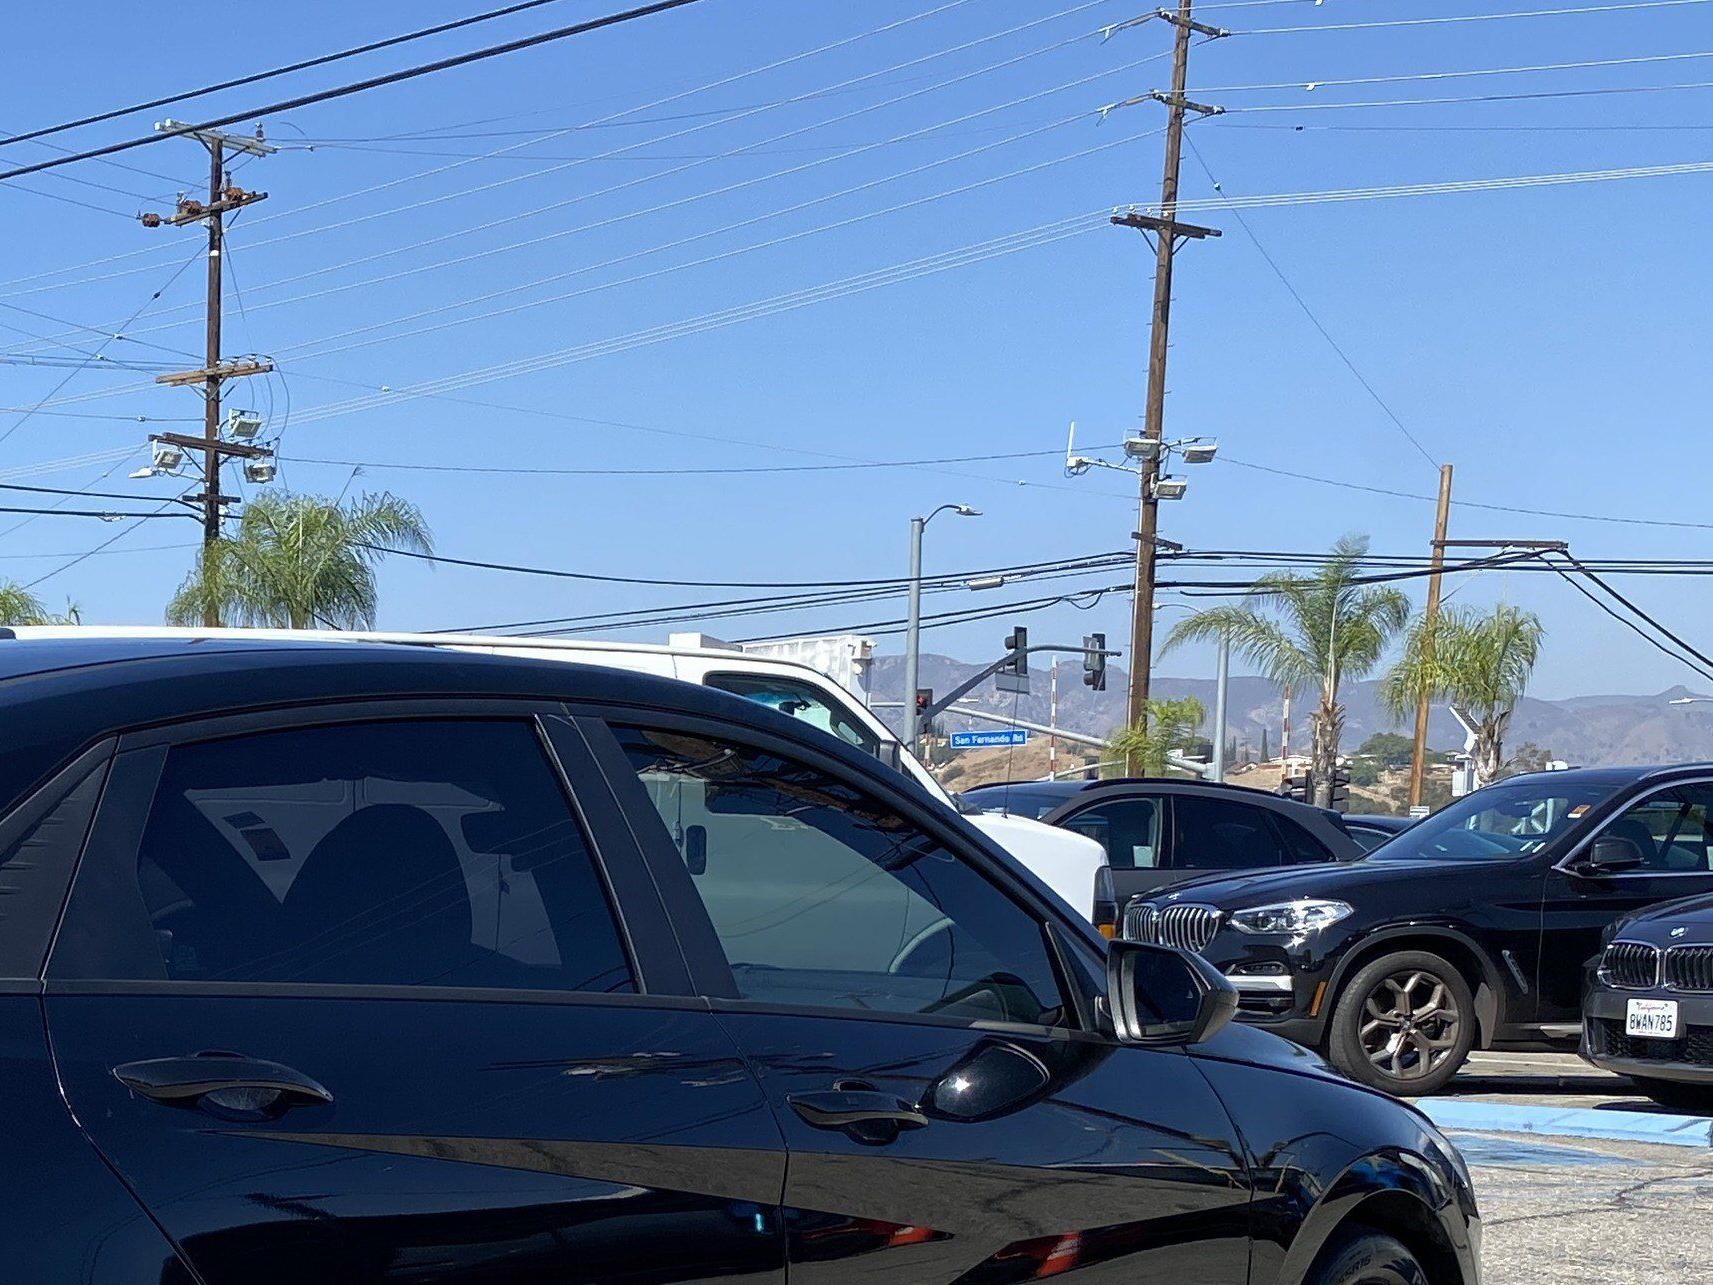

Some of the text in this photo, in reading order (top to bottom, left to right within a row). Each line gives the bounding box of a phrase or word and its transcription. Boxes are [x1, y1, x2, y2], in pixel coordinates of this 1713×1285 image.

[955, 733, 1024, 745] San Fernando Rd
[1630, 1014, 1672, 1032] 8WAN785
